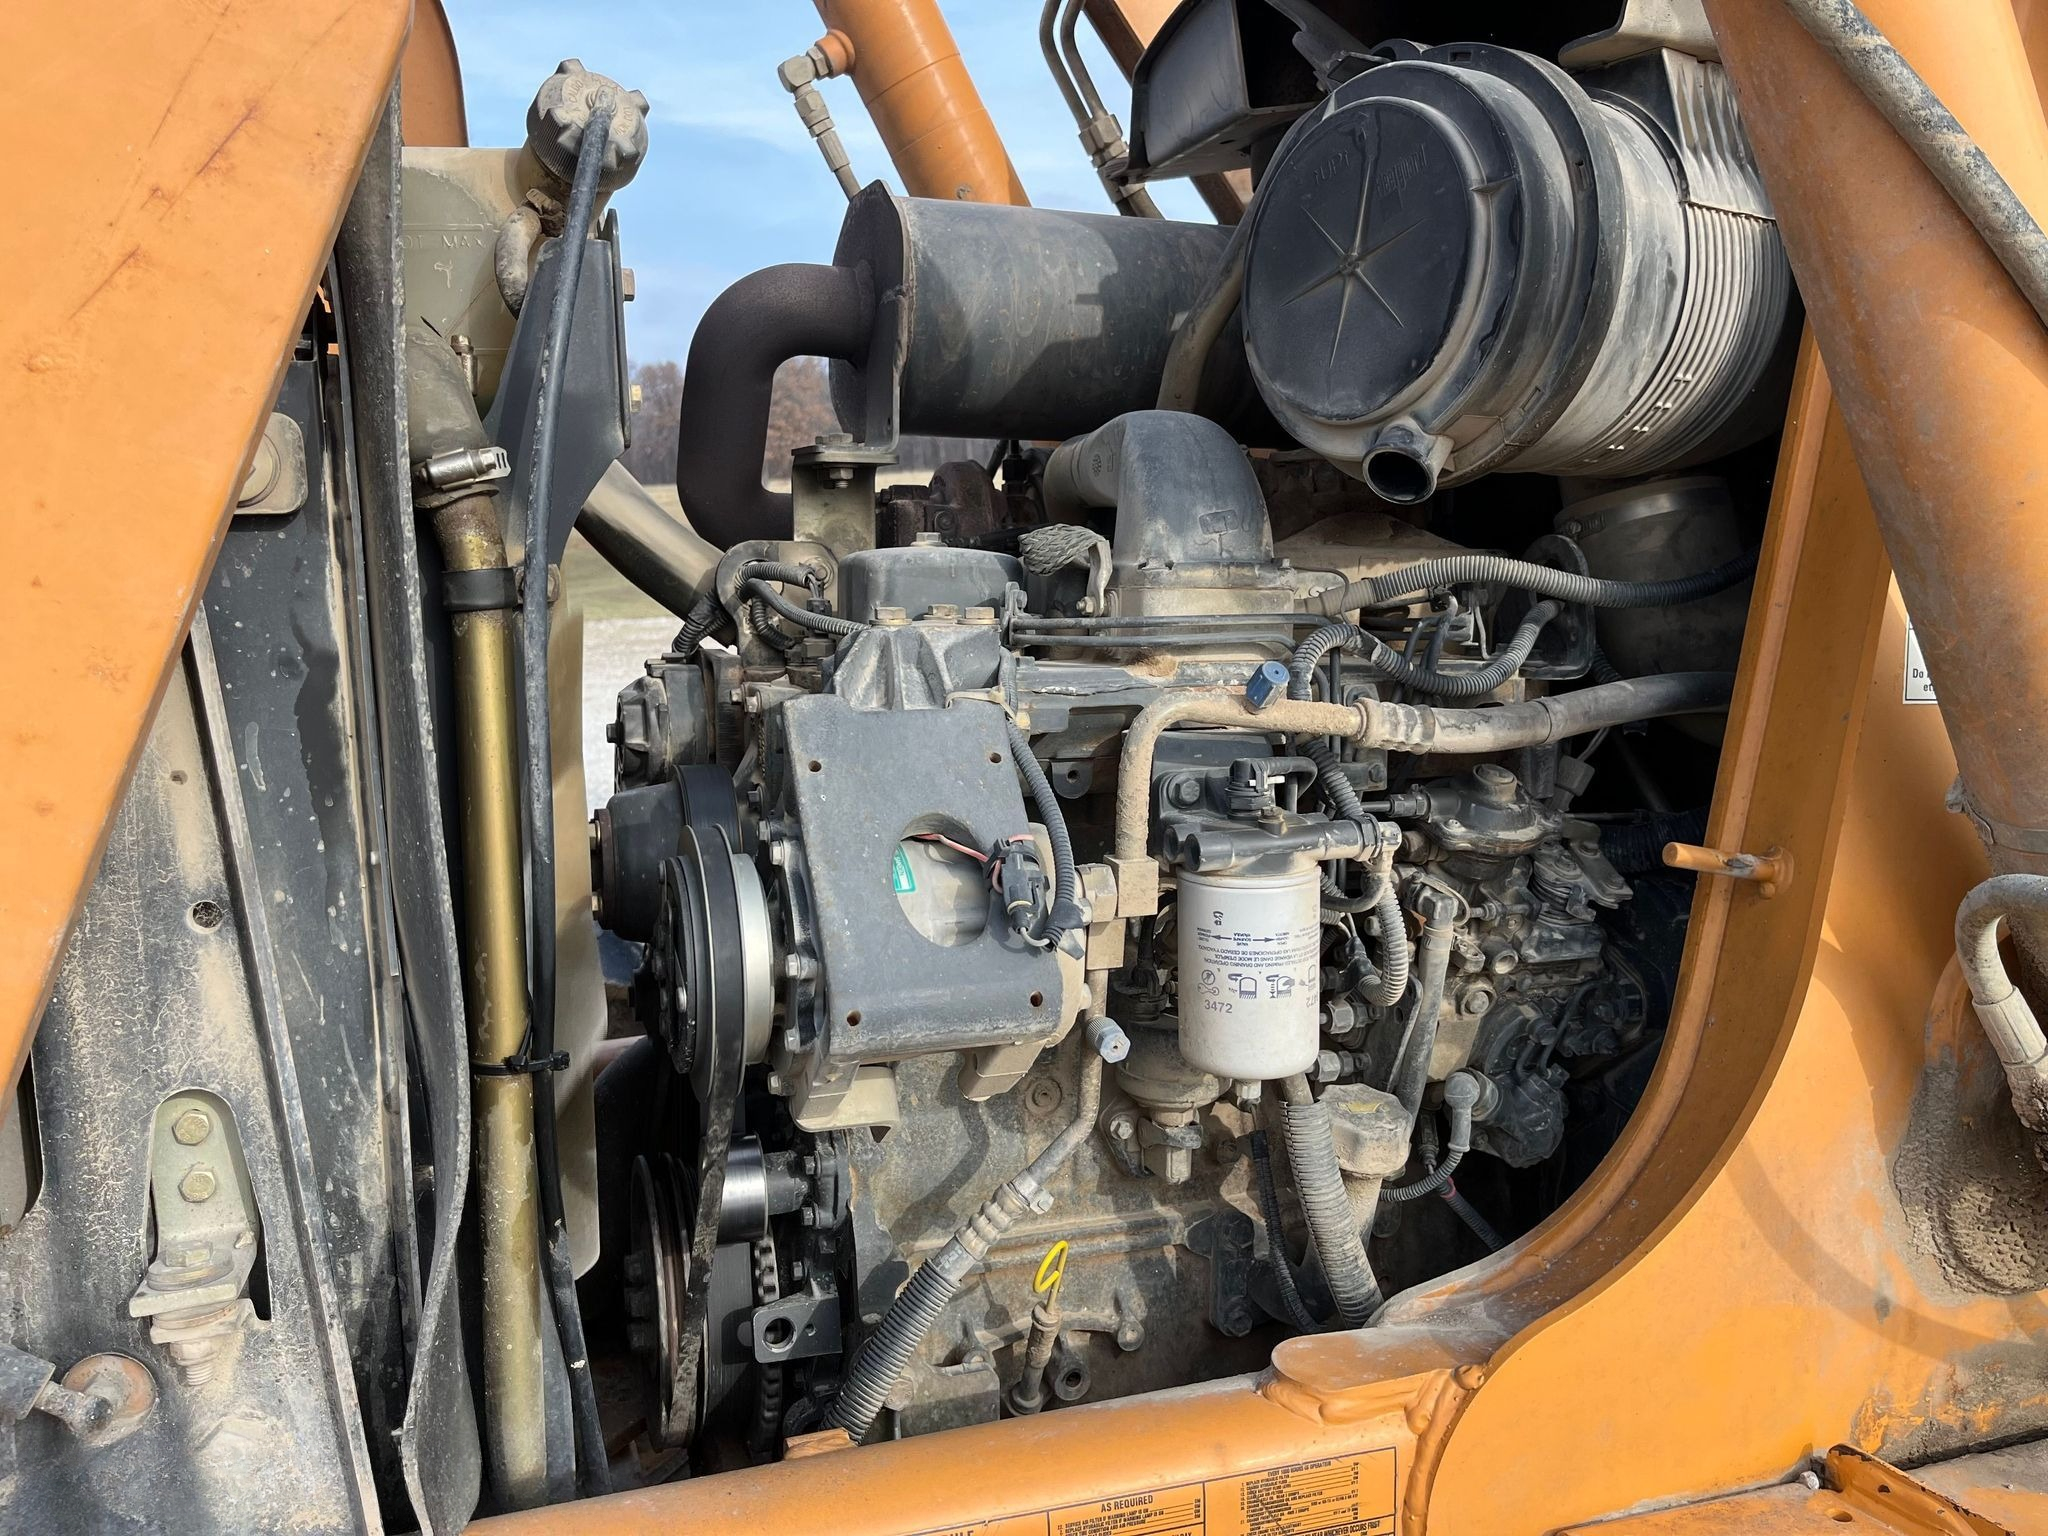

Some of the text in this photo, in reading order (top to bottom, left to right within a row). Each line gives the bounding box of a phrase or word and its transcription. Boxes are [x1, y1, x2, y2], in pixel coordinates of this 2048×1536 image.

[1912, 668, 1924, 679] Do
[1204, 1000, 1233, 1014] 3472
[1101, 1495, 1153, 1513] AS REQUIRED
[1350, 1523, 1367, 1533] OCCURS
